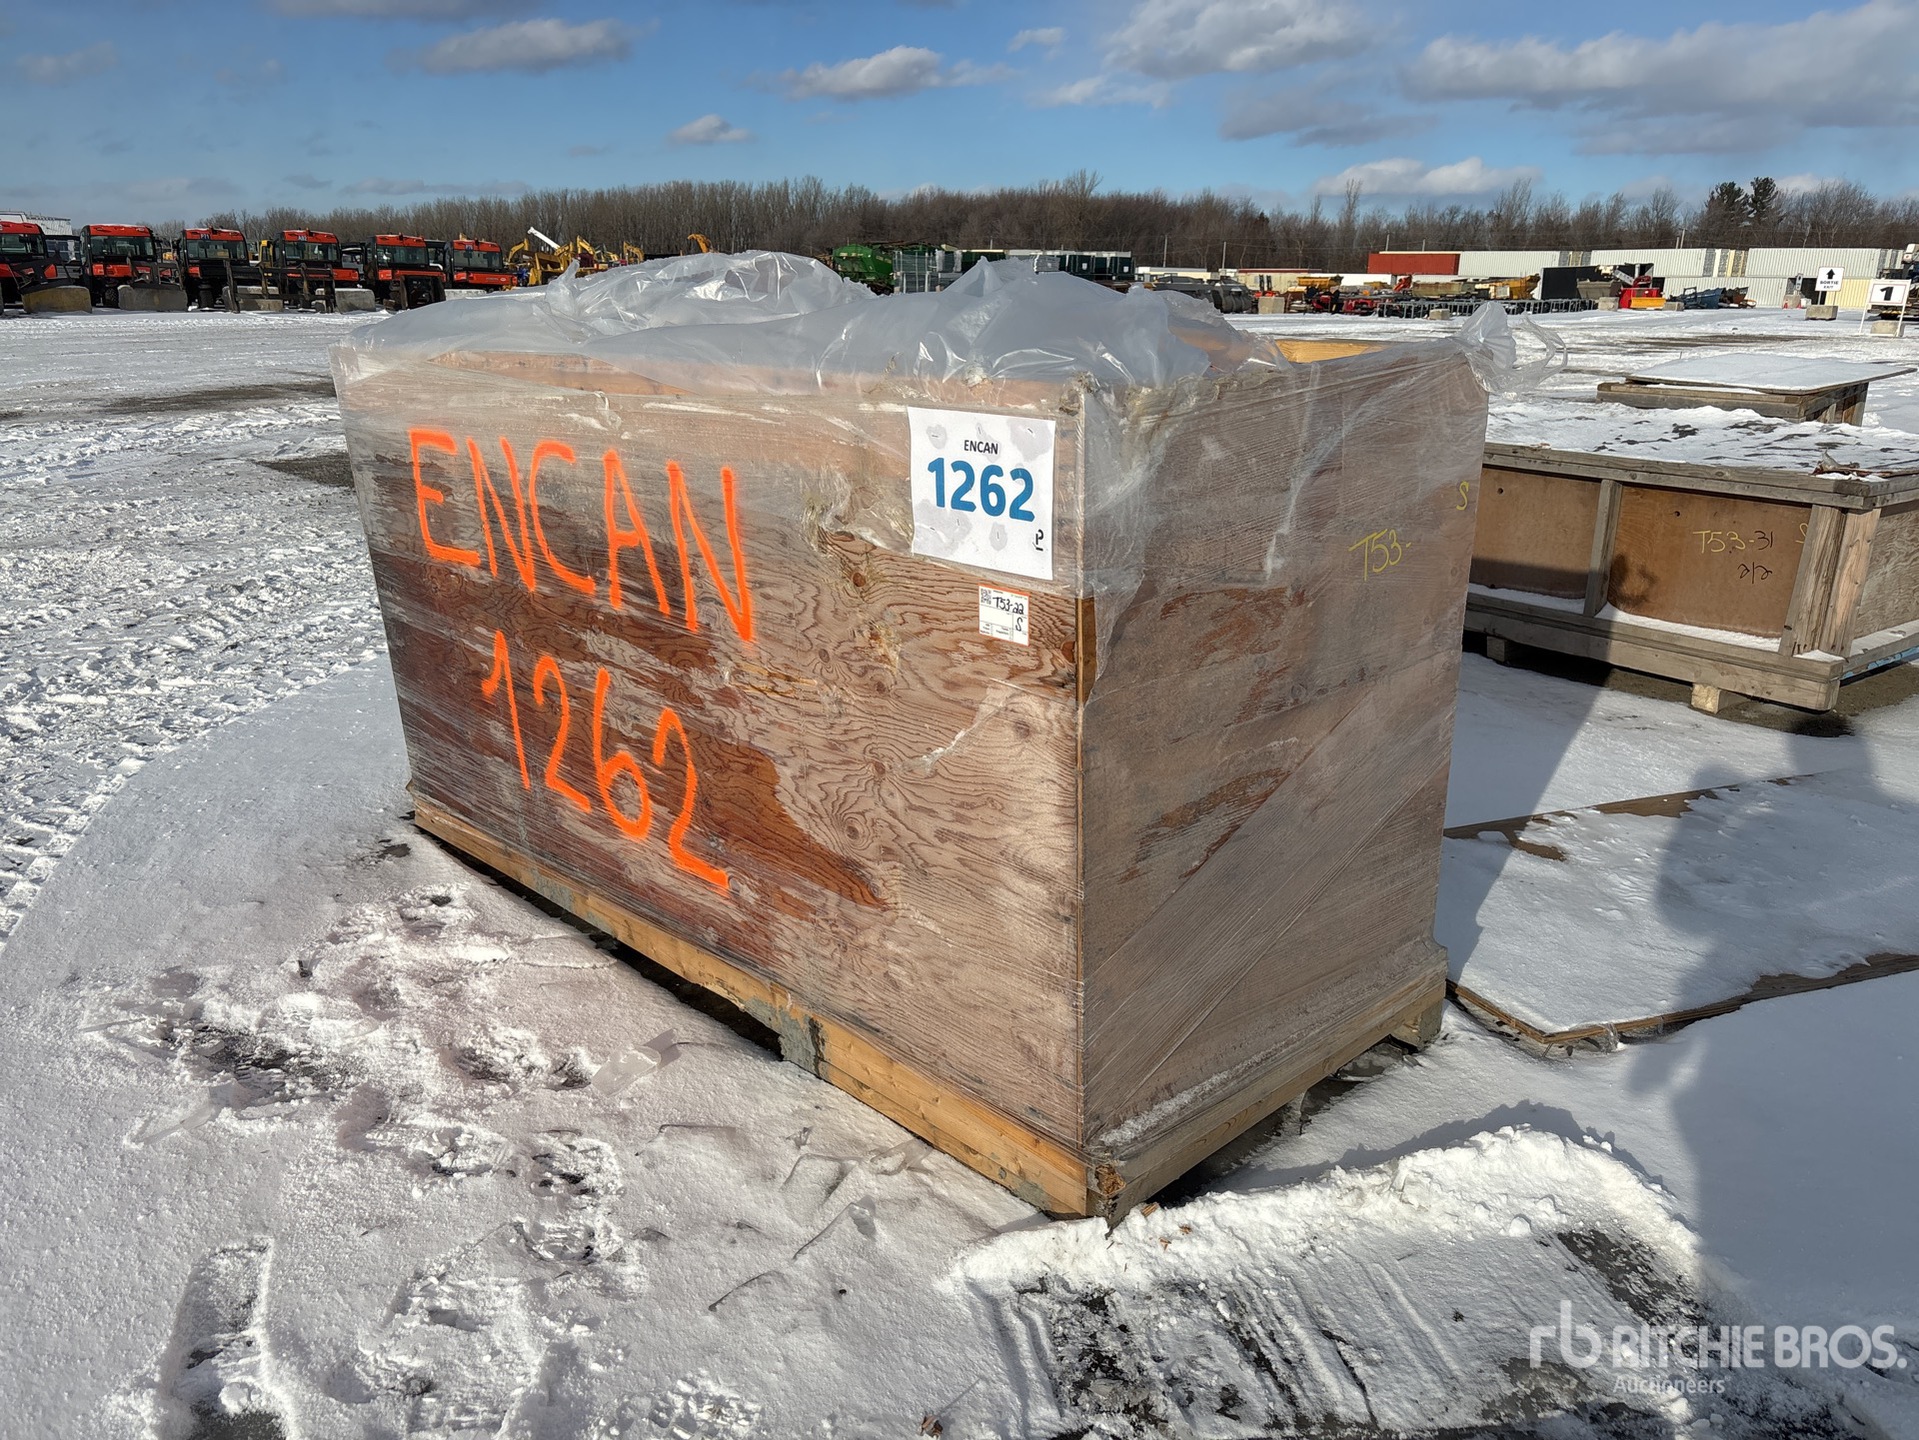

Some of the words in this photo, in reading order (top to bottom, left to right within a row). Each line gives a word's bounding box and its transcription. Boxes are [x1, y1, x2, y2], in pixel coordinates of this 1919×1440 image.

[1880, 286, 1894, 301] 1
[964, 440, 998, 455] ENCAN
[927, 457, 1036, 522] 1262
[1456, 481, 1470, 511] S
[408, 427, 755, 642] ENCAN
[1015, 616, 1024, 632] S
[482, 630, 730, 896] 1262
